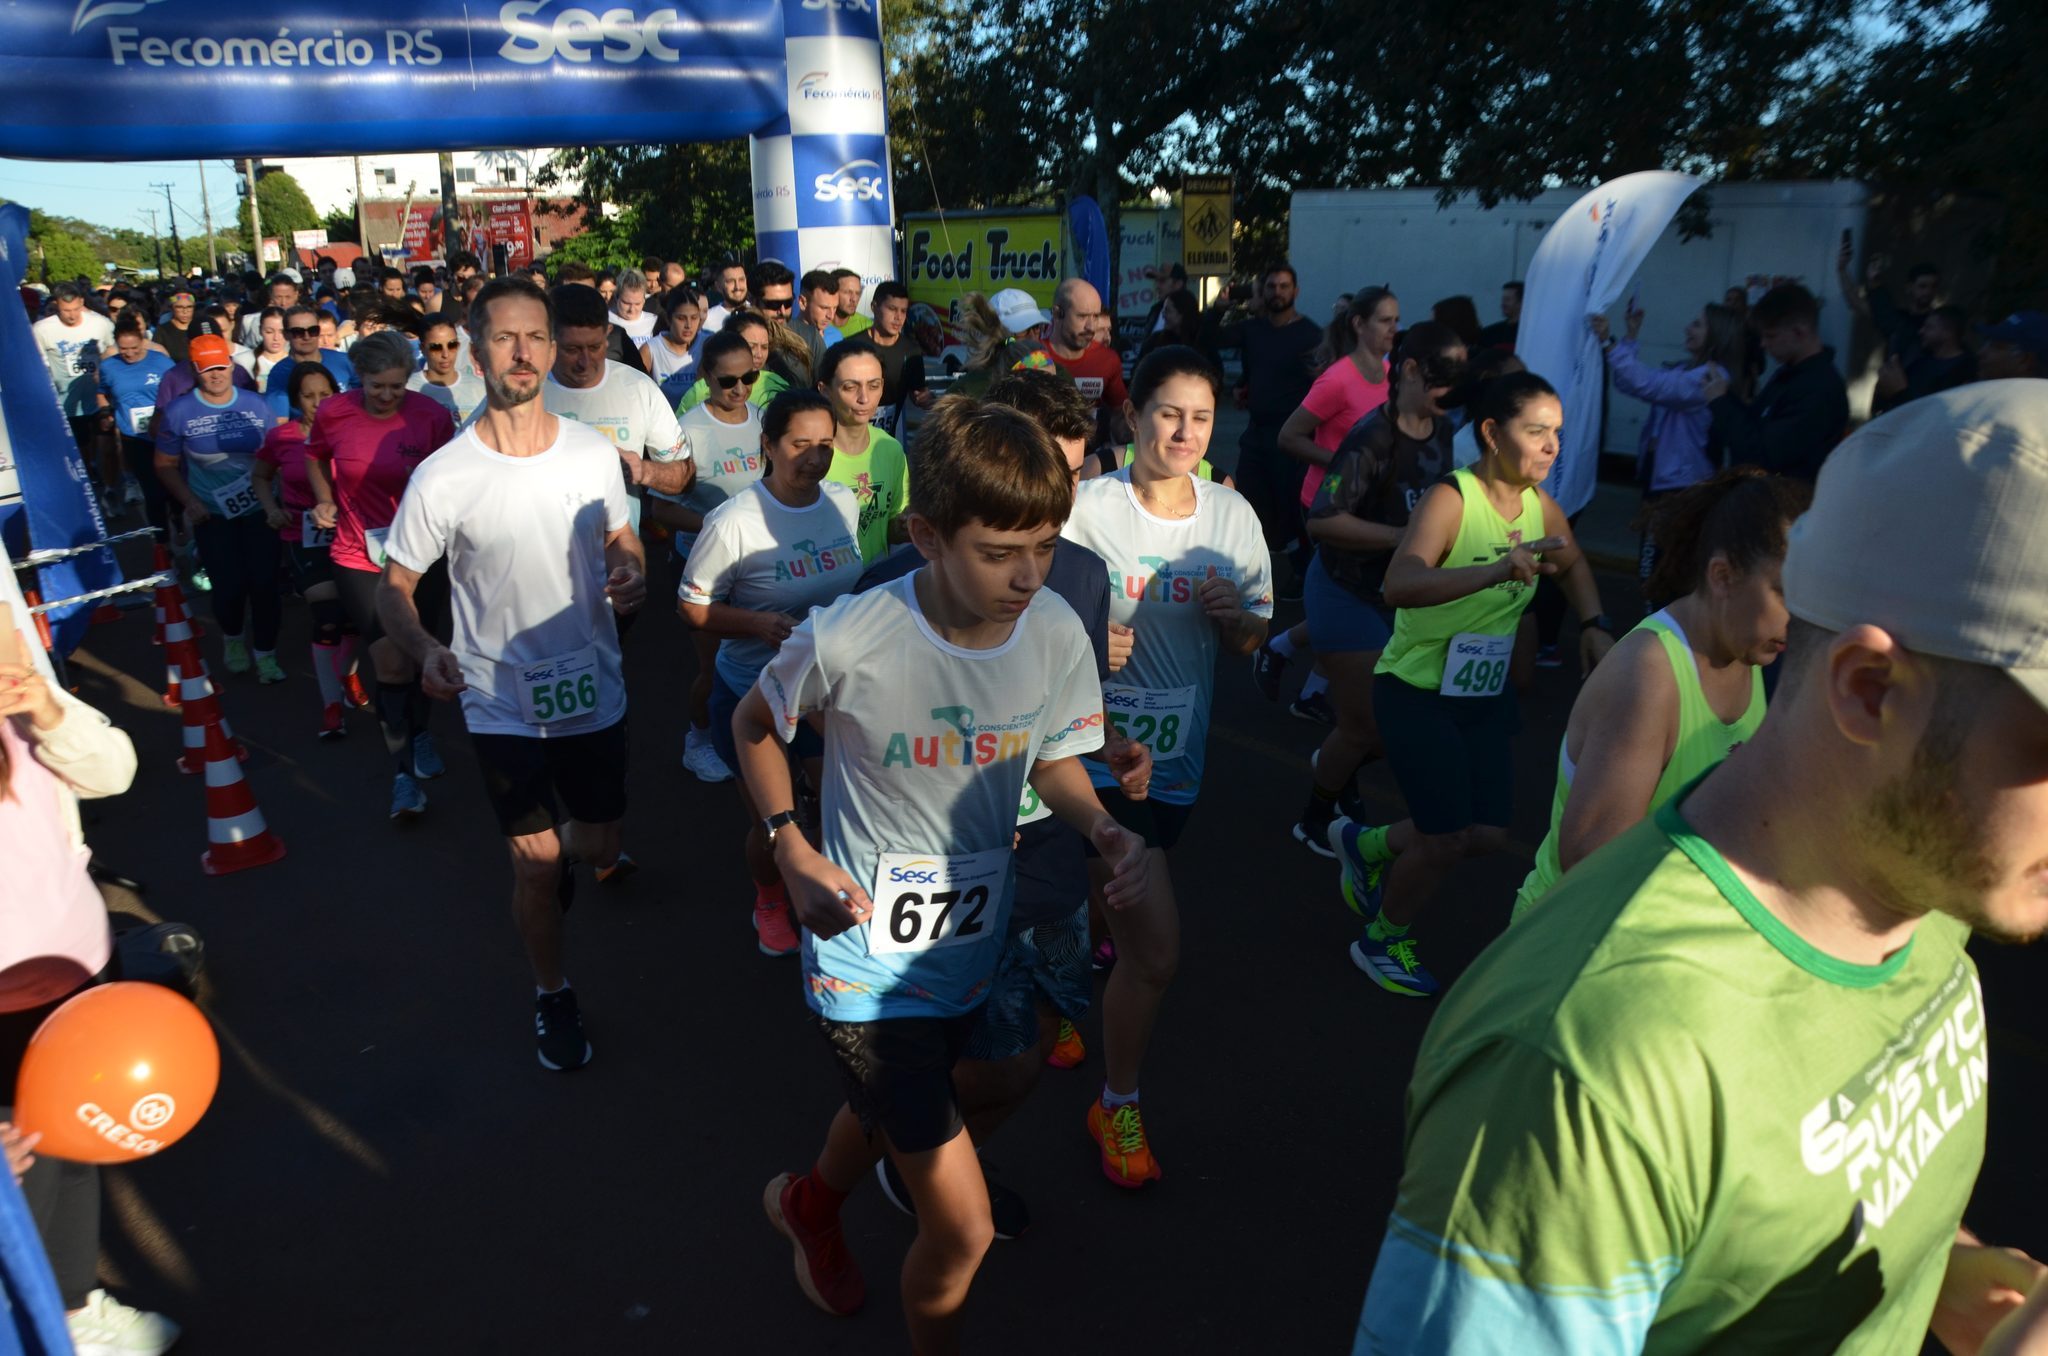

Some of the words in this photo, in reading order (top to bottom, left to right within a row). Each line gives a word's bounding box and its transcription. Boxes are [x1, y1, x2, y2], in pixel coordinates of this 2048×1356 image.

[107, 27, 374, 67] Fecomércio
[386, 29, 443, 66] RS
[498, 0, 681, 65] Sesc
[814, 172, 884, 202] Sesc
[910, 228, 974, 281] Food
[986, 227, 1058, 281] Truck
[184, 419, 265, 436] LONGEVIDADE
[1456, 643, 1485, 657] Sesc
[524, 669, 555, 682] Sesc
[1453, 659, 1506, 693] 498
[532, 673, 596, 720] 566
[1103, 692, 1140, 709] Sesc
[1108, 711, 1180, 754] 528
[889, 867, 939, 885] Sesc
[889, 885, 989, 944] 672
